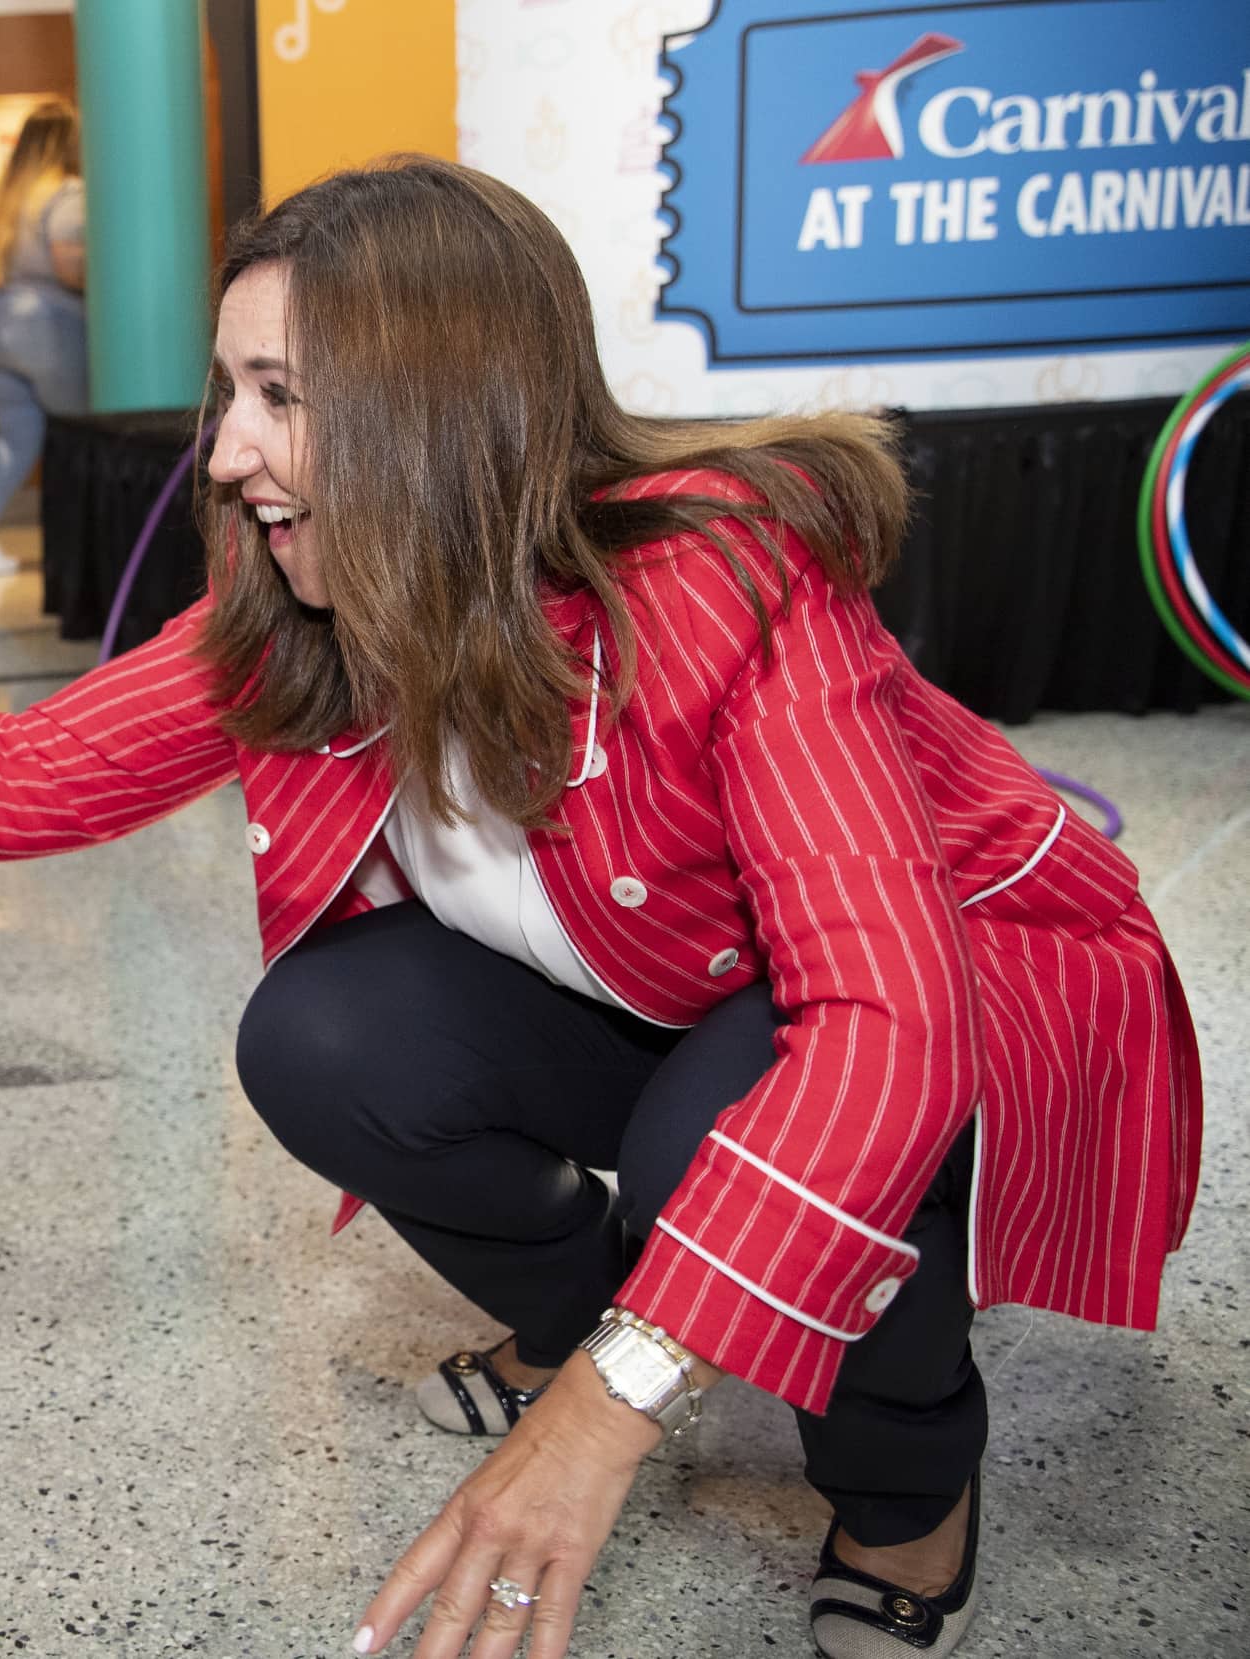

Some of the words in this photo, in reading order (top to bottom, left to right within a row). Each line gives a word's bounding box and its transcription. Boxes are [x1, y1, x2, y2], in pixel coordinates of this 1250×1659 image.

[797, 184, 873, 251] AT
[889, 175, 999, 246] THE
[1016, 162, 1250, 239] CARNIVAL
